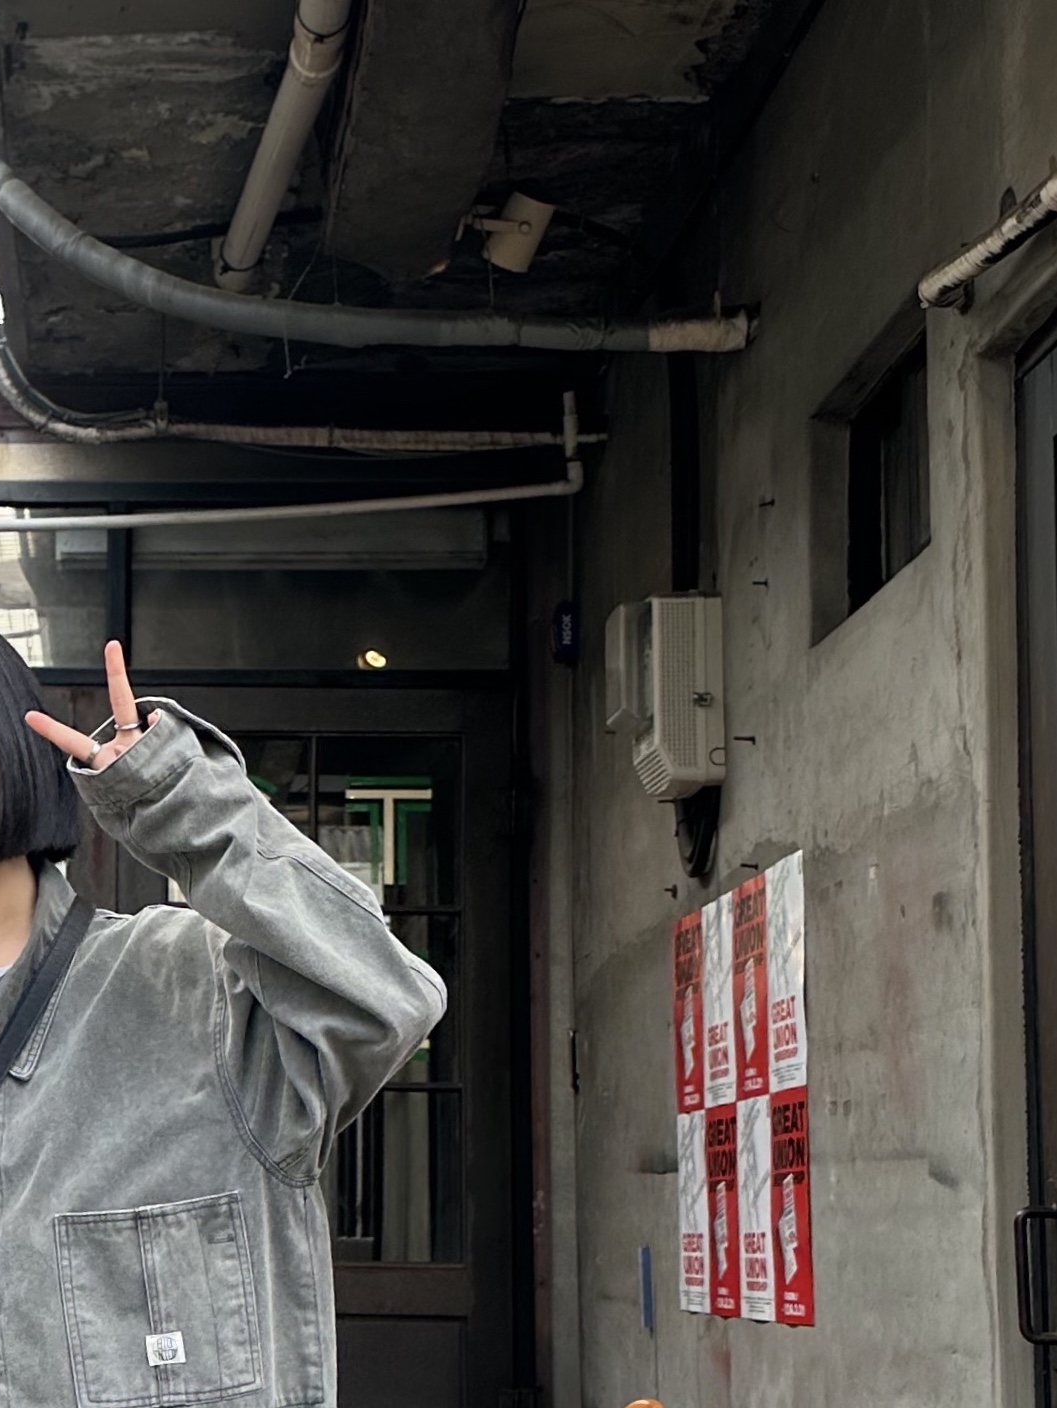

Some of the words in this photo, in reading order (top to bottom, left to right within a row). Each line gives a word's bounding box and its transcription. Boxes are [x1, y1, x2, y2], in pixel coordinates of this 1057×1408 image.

[771, 995, 796, 1024] GREAT
[708, 1116, 737, 1148] GREAT
[772, 1101, 805, 1135] GREAT
[773, 1138, 805, 1170] UNION
